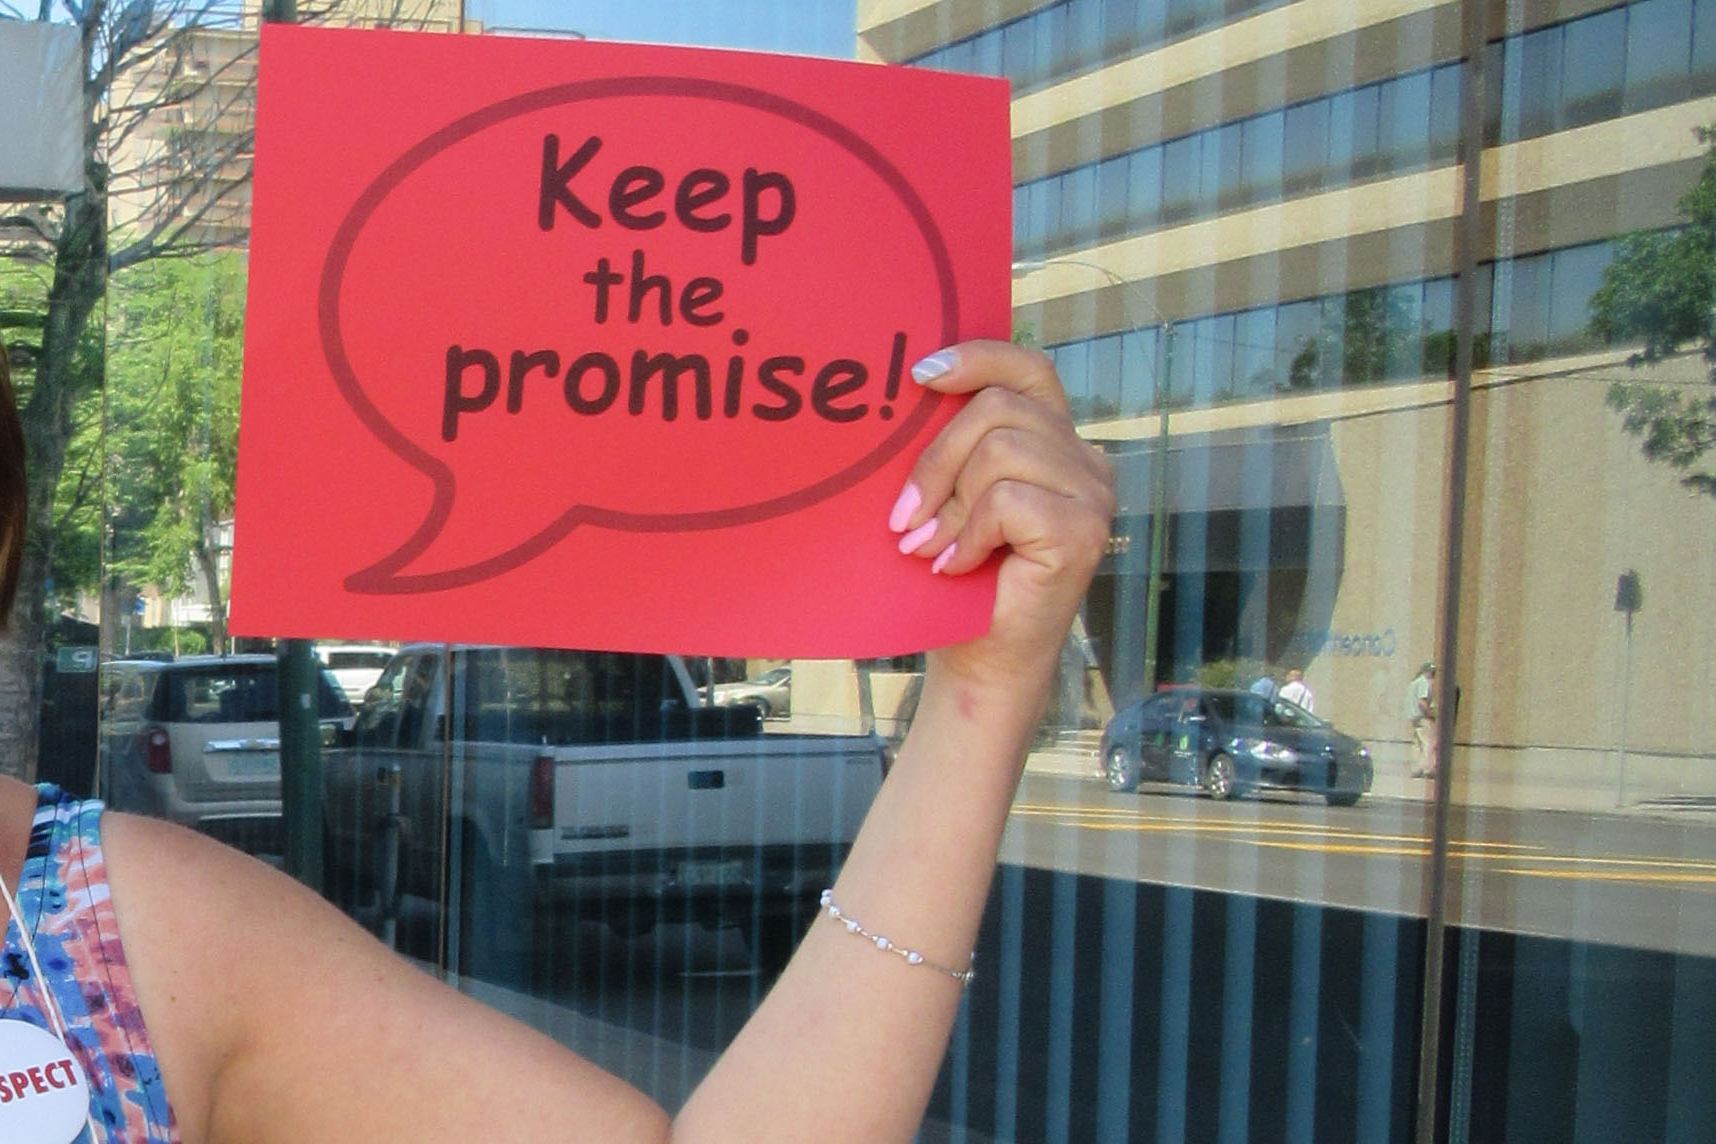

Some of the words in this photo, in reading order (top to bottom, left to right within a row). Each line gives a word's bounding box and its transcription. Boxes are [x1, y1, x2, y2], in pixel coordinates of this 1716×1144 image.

[540, 134, 795, 265] Keep
[583, 250, 724, 326] the
[442, 329, 906, 441] promise!
